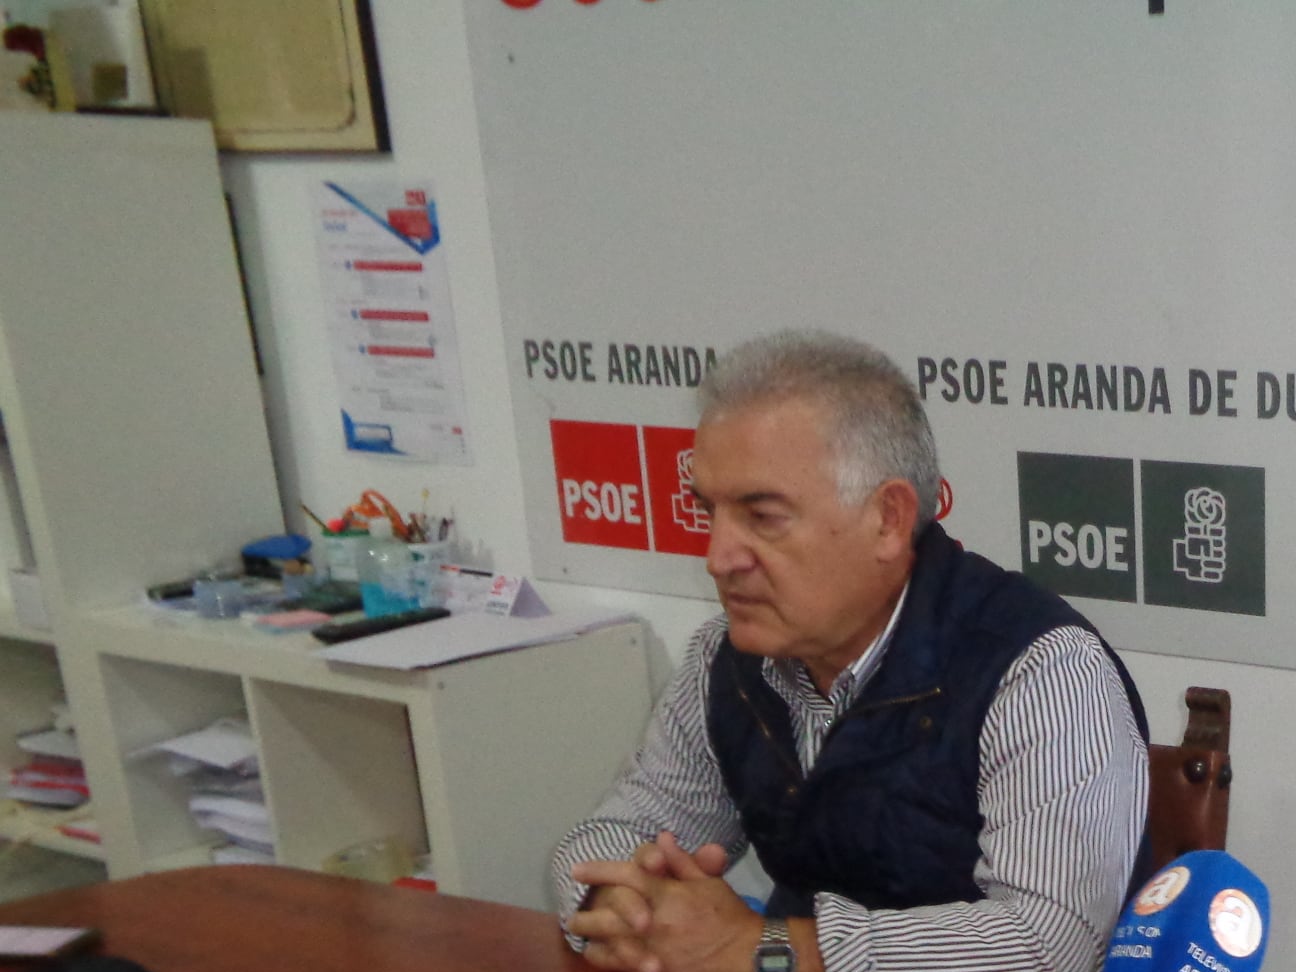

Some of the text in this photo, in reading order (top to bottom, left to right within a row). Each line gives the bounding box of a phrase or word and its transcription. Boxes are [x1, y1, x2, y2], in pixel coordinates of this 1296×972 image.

[523, 339, 596, 383] PSOE
[917, 357, 1009, 405] PSOE
[1023, 362, 1171, 414] ARANDA
[1189, 369, 1238, 418] DE
[562, 479, 641, 524] PSOE
[1028, 520, 1128, 571] PSOE
